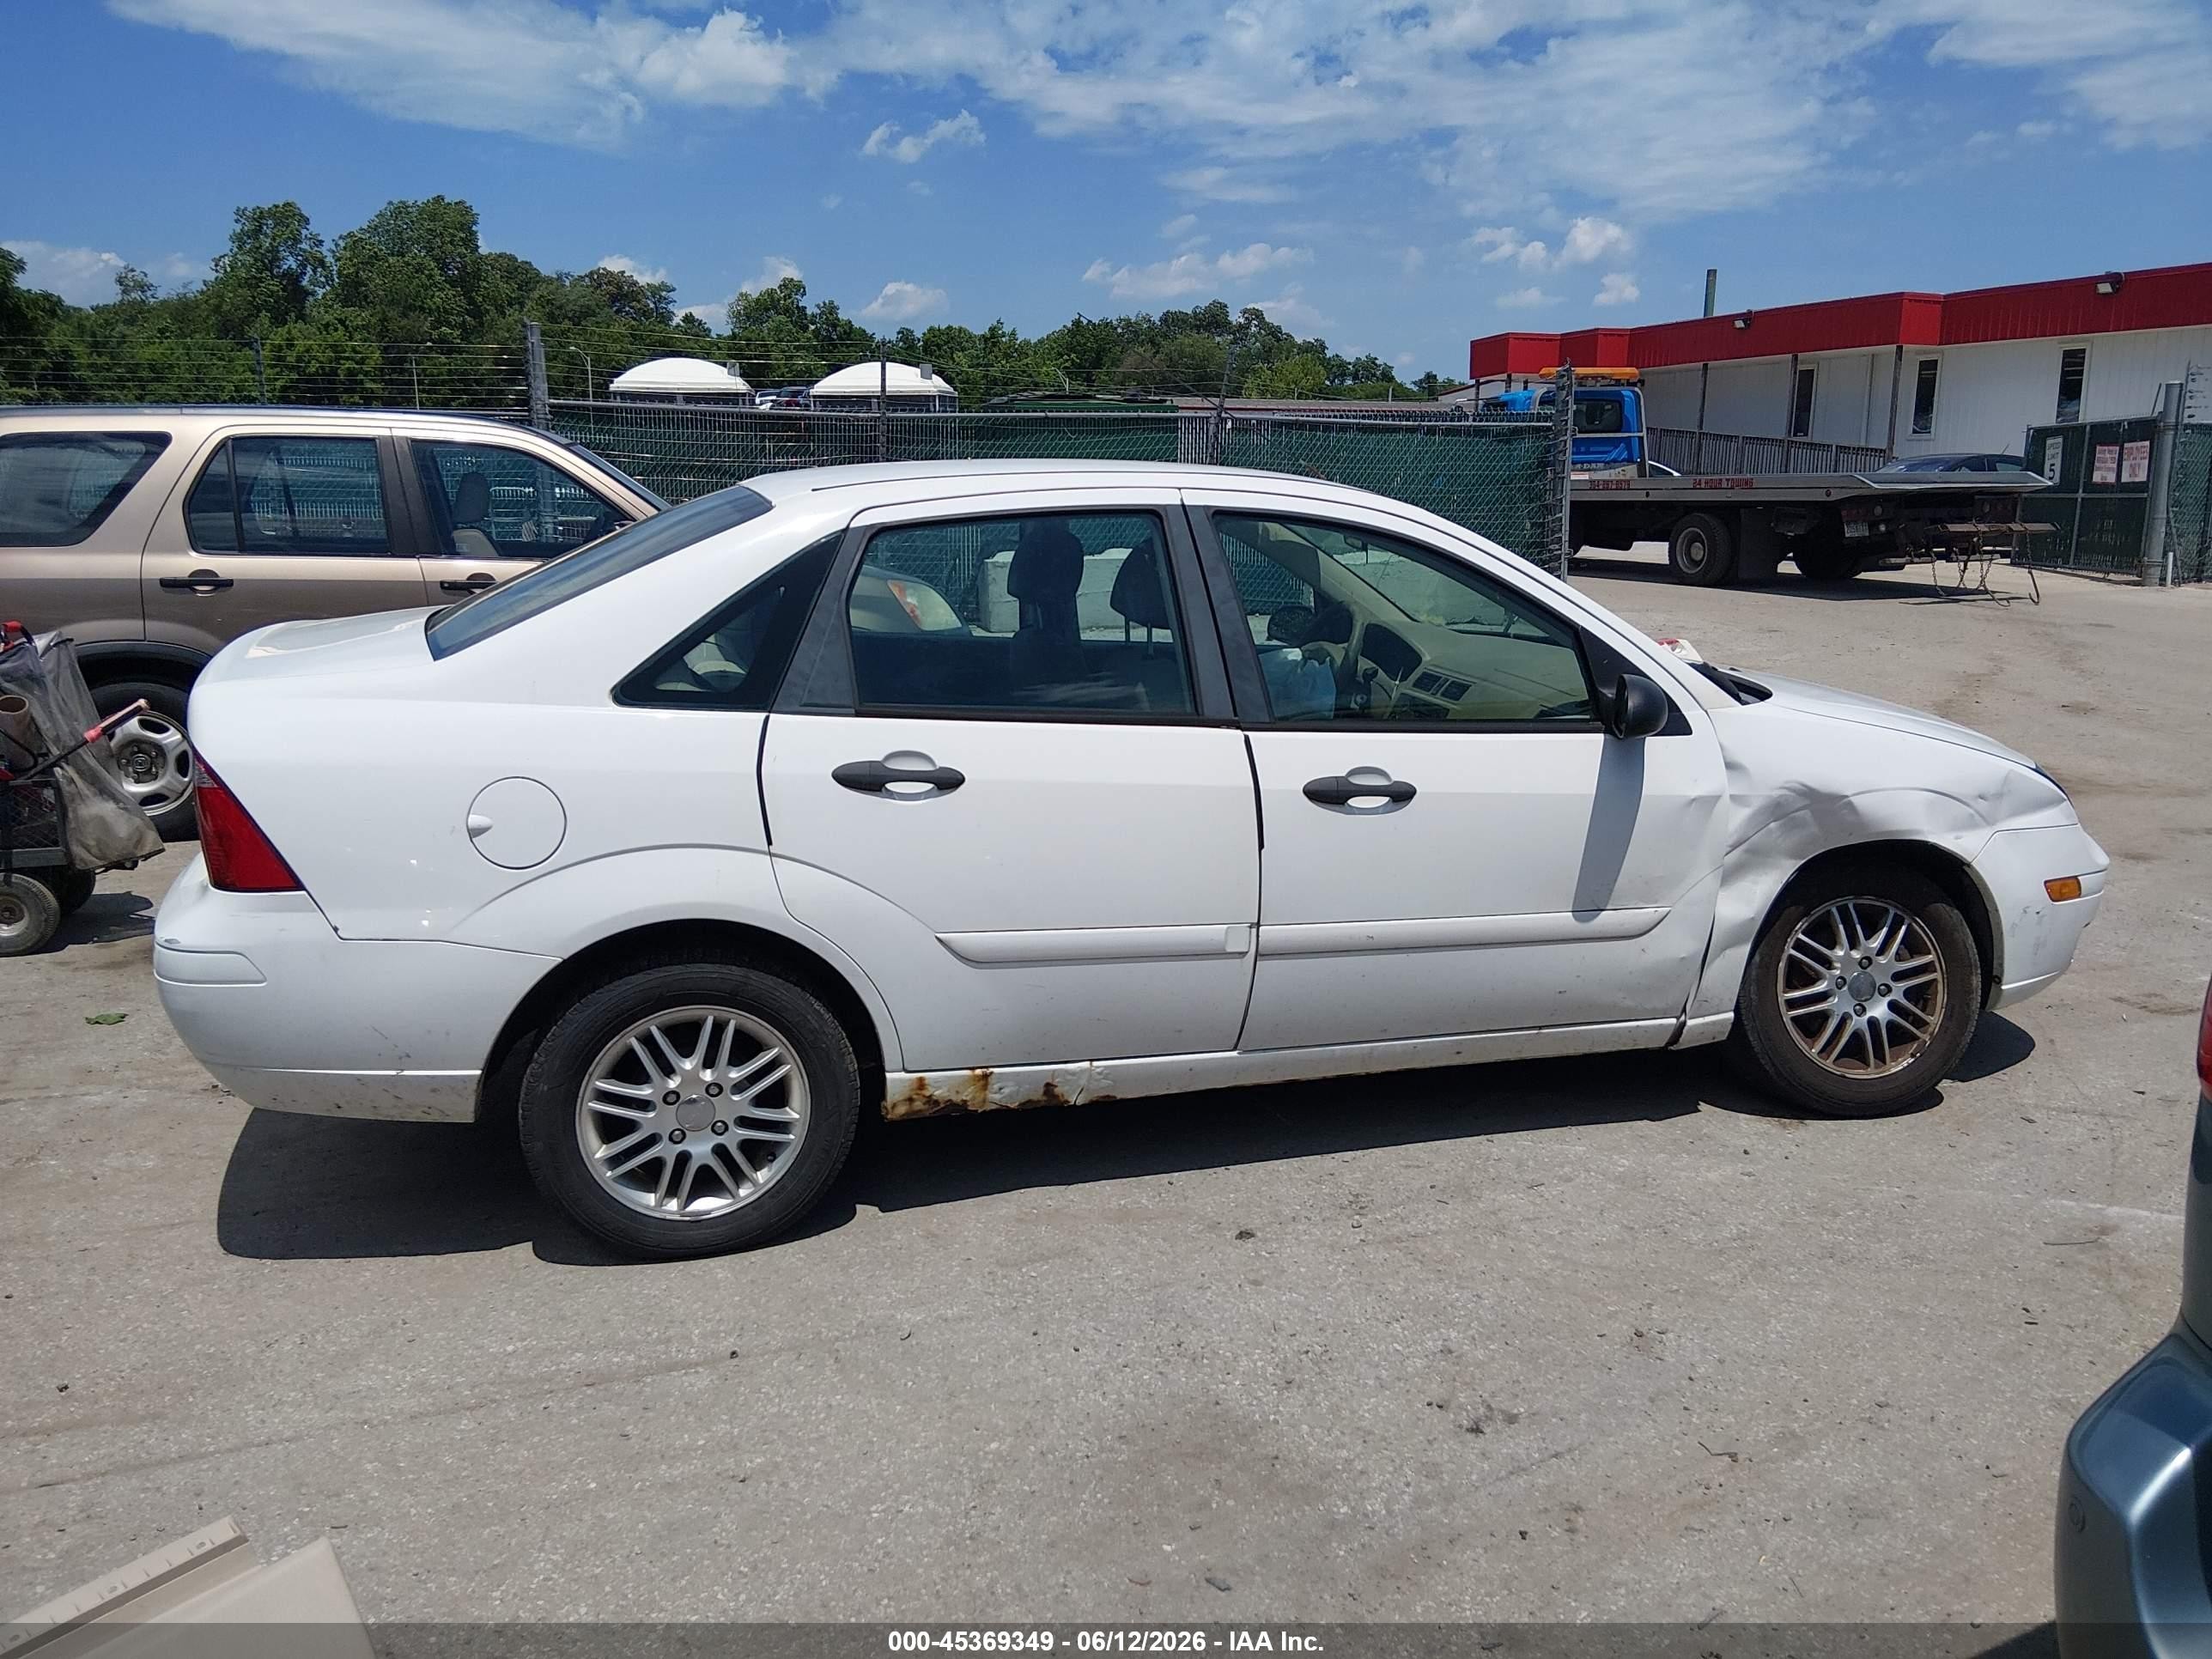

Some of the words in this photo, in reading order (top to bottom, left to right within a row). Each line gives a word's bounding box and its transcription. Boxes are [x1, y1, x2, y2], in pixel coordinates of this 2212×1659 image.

[2049, 463, 2056, 480] 5
[1692, 478, 1702, 488] 24
[1705, 478, 1723, 488] HOUR
[1725, 478, 1753, 488] TOWING
